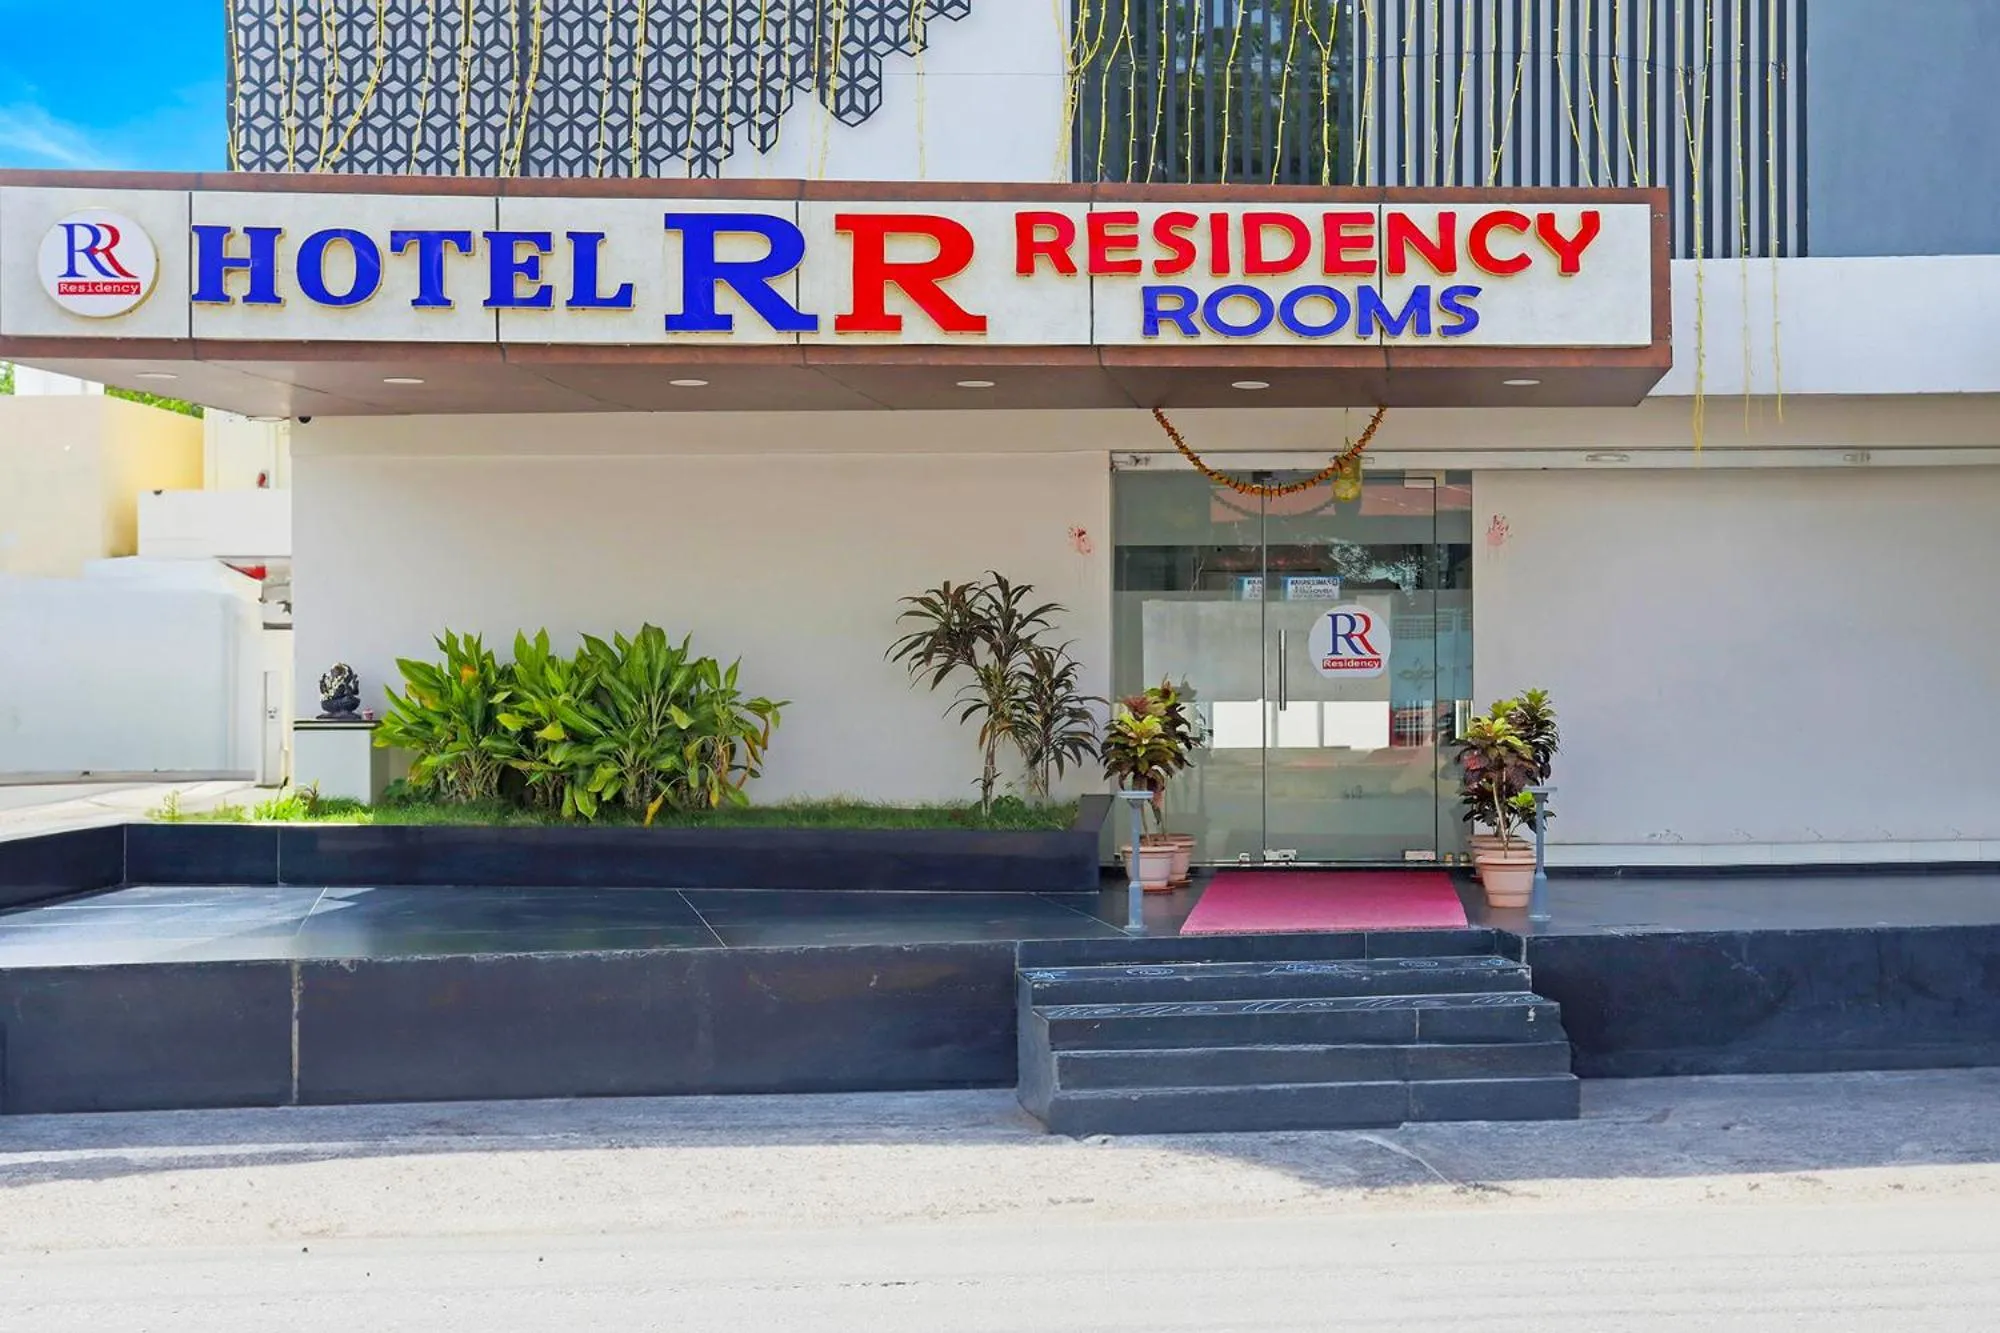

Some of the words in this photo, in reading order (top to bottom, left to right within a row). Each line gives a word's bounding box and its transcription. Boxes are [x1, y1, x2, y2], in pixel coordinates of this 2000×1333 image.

[57, 223, 138, 278] RR
[191, 225, 635, 308] HOTEL
[1015, 210, 1601, 276] RESIDENCY
[59, 282, 139, 294] Residency
[1142, 284, 1482, 338] ROOMS
[1327, 613, 1381, 656] RR
[1323, 659, 1380, 669] Residency
